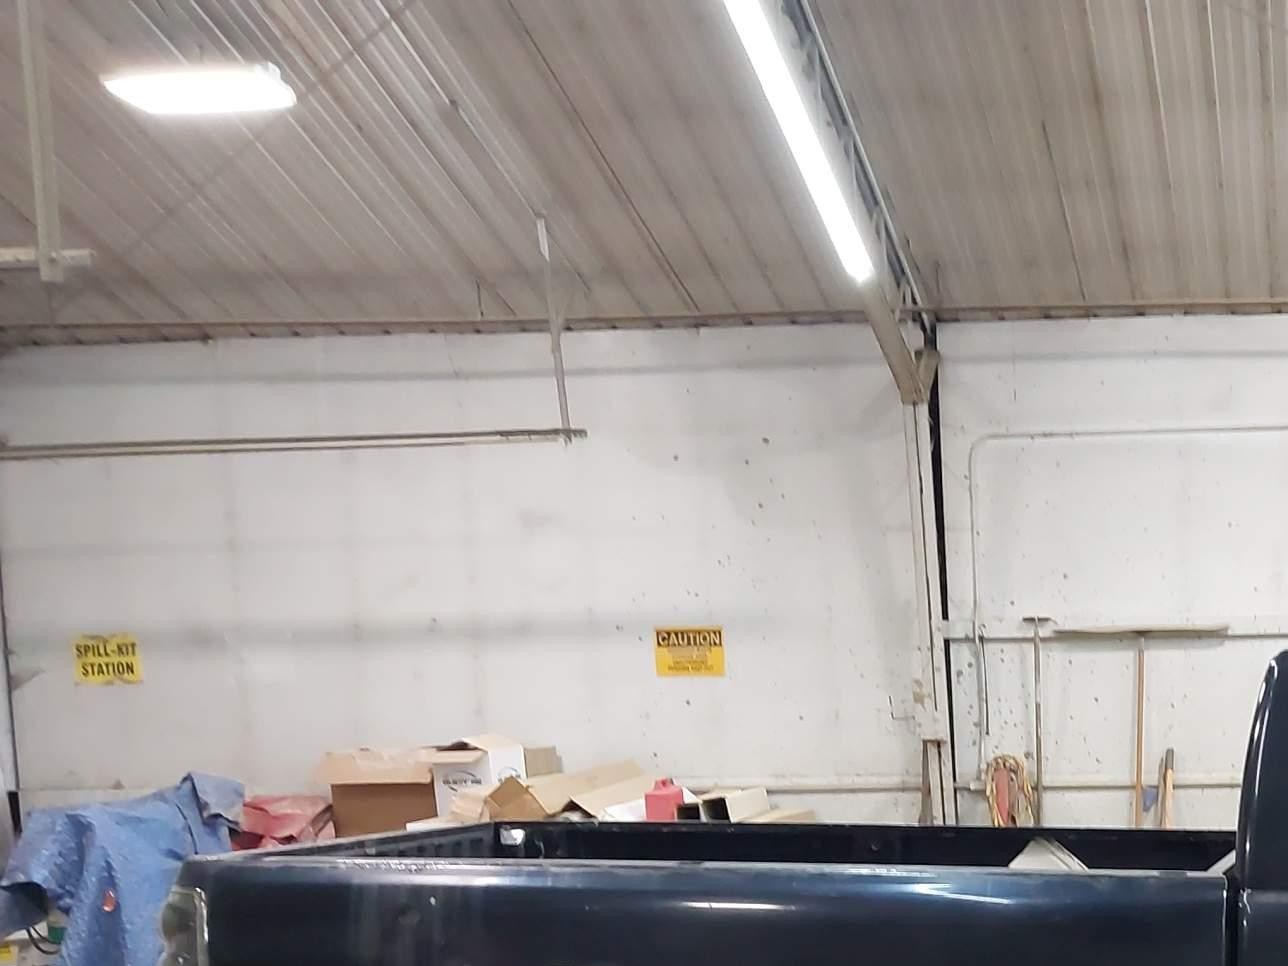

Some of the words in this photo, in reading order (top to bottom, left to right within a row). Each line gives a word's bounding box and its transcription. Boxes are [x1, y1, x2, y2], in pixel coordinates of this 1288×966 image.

[658, 631, 720, 647] CAUTION
[75, 642, 137, 659] SPILL-KIT
[81, 661, 135, 678] STATION
